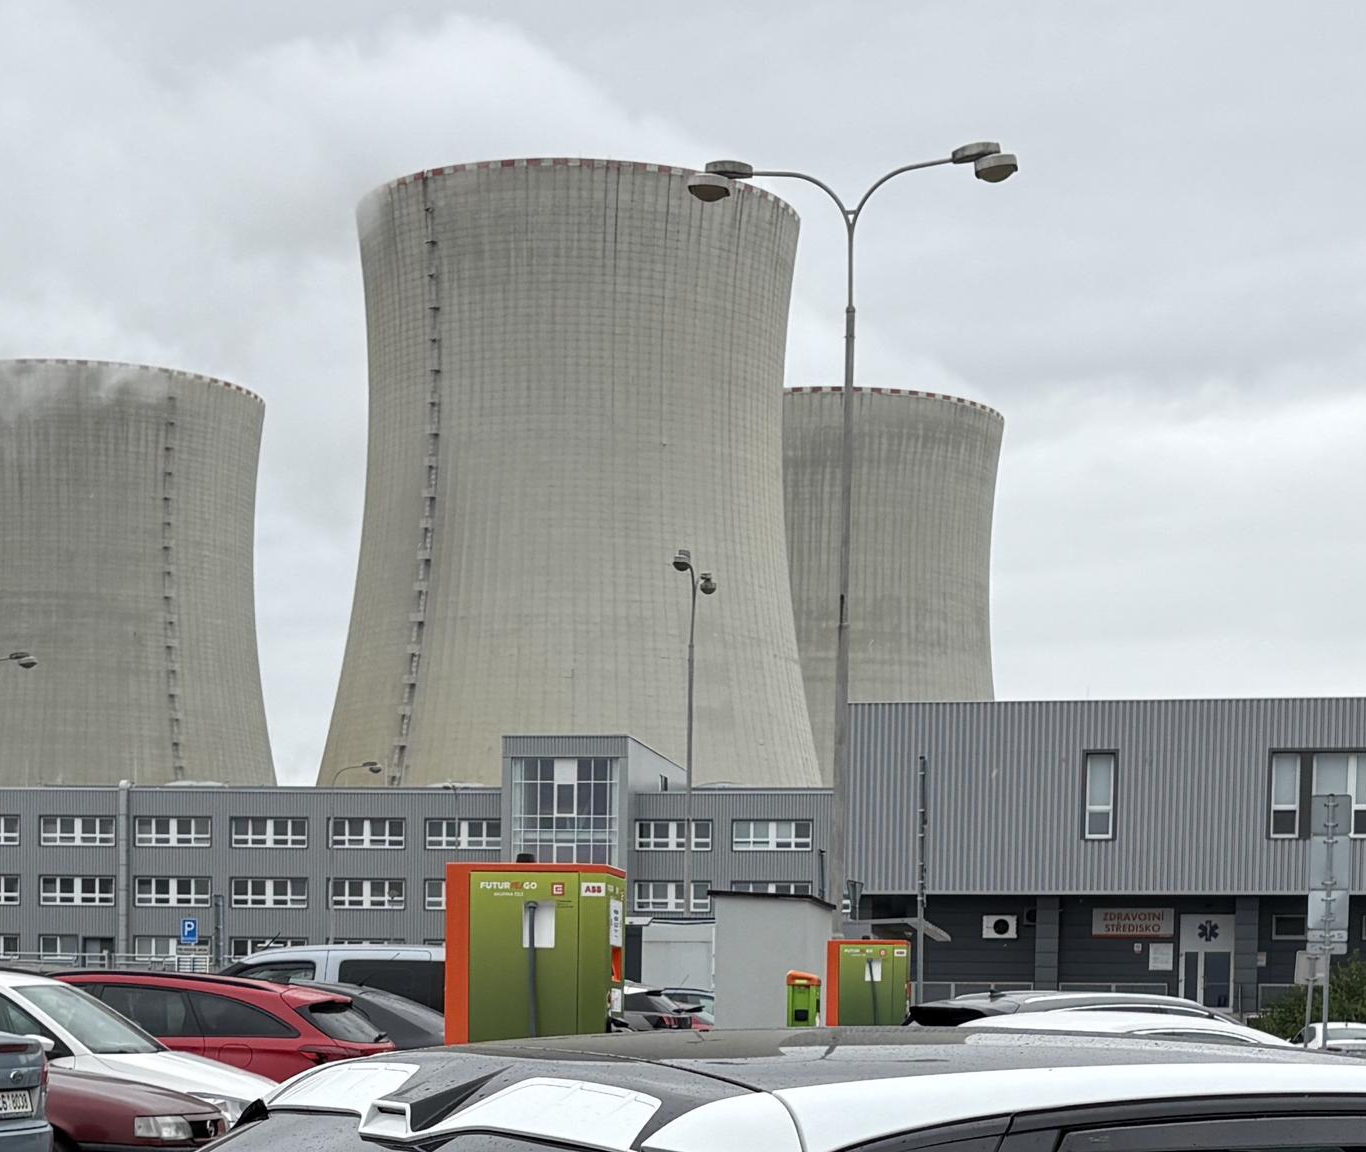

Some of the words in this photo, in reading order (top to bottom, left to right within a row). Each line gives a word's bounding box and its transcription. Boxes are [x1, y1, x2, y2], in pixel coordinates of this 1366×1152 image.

[479, 881, 537, 890] FUTURGO
[584, 885, 602, 894] ABB
[185, 921, 195, 936] P
